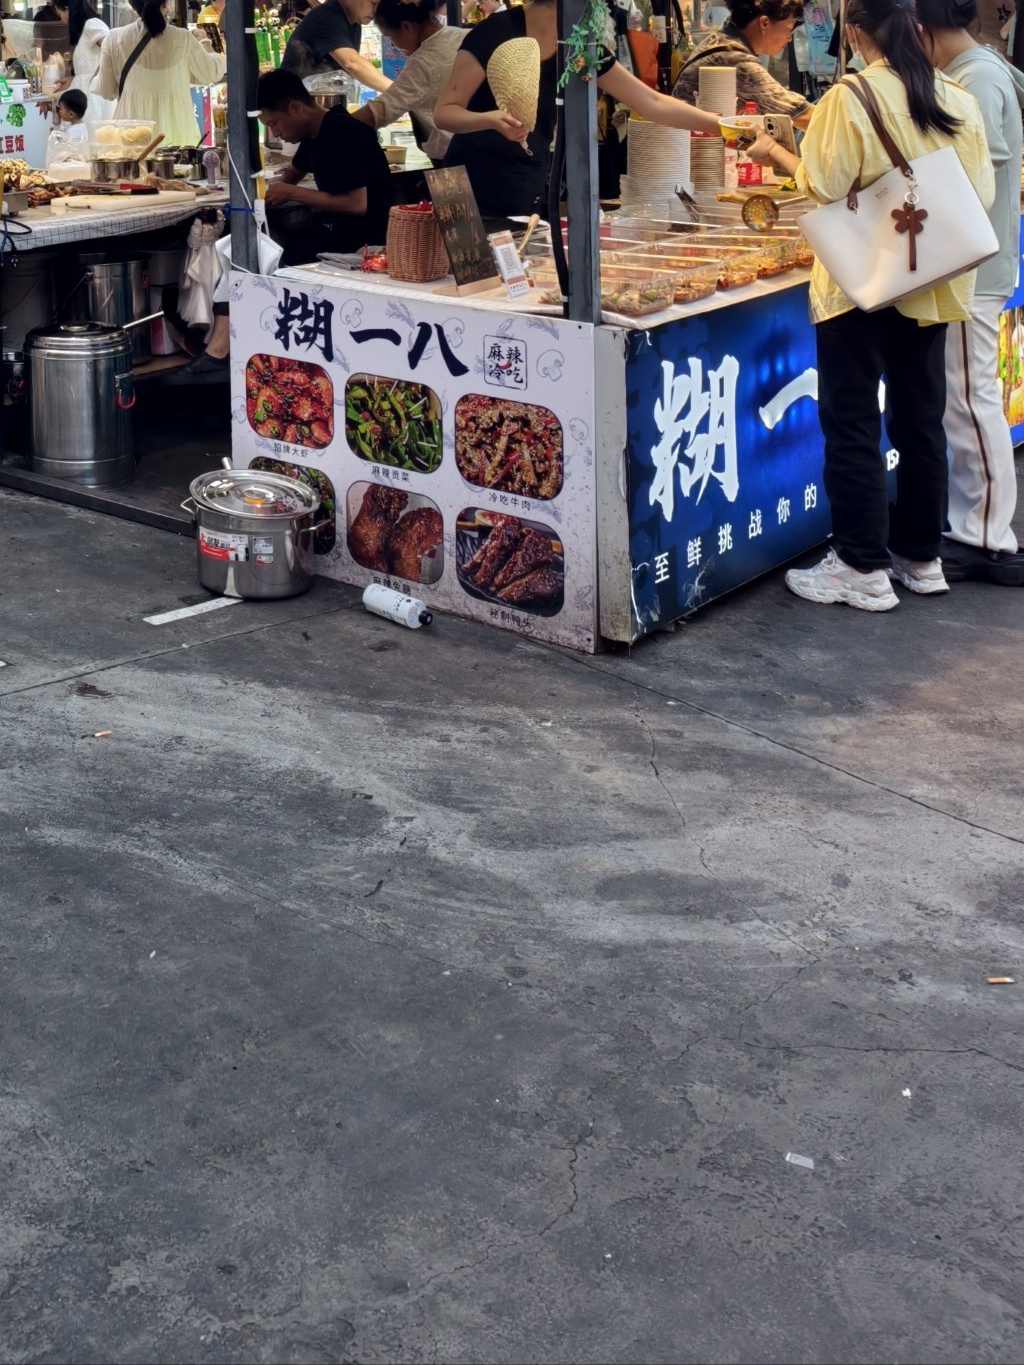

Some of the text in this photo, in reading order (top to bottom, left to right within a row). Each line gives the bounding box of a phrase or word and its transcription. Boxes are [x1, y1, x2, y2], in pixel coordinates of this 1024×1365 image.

[275, 287, 470, 377] 糊一八
[487, 342, 524, 365] 麻辣
[488, 362, 524, 384] 冷吃
[274, 443, 309, 459] 招牌大虾
[371, 465, 410, 483] 麻辣贡菜
[488, 491, 532, 511] 冷吃牛肉
[654, 482, 818, 585] 至鲜挑战你的
